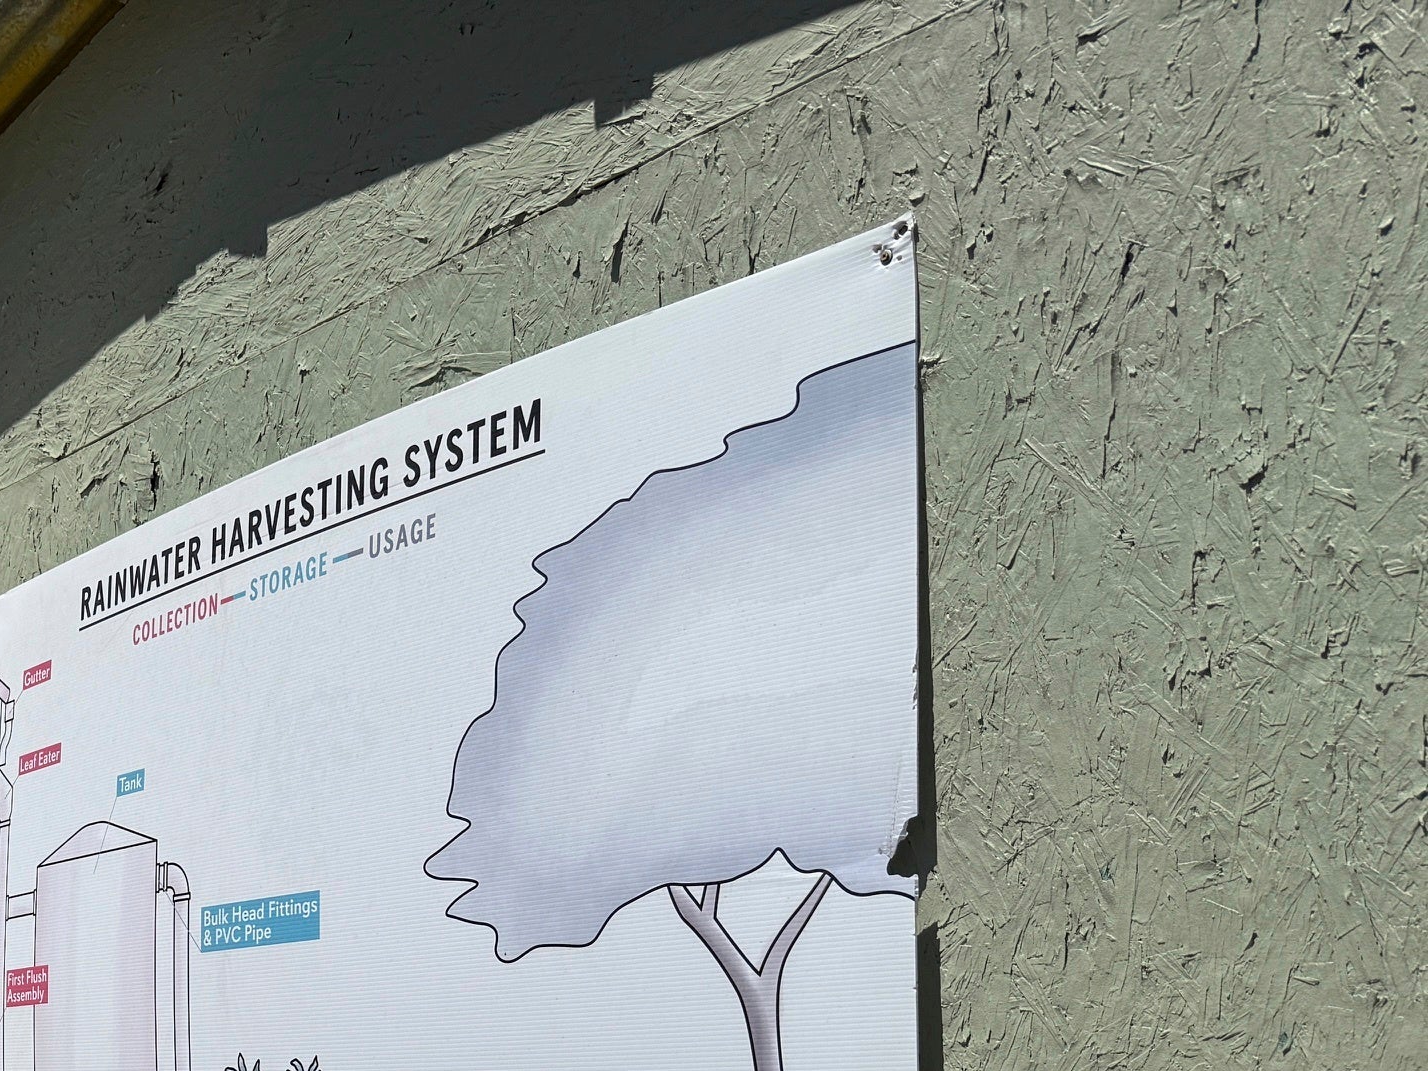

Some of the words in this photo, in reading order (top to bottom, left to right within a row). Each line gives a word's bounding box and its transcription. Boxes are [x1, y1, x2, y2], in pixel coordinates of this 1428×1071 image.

[80, 535, 201, 621] RAINWATER
[211, 458, 388, 564] HARVESTING
[402, 398, 542, 488] SYSTEM
[132, 592, 219, 646] COLLECTION
[249, 551, 328, 601] STORAGE
[368, 512, 437, 559] USAGE
[24, 666, 50, 685] Gutter
[20, 754, 37, 773] Leaf
[38, 748, 61, 767] Eater
[119, 774, 142, 793] Tank
[203, 908, 228, 927] Bulk
[231, 903, 265, 923] Head
[268, 898, 318, 920] Fittings
[203, 930, 213, 947] &
[215, 927, 242, 945] PVC
[244, 926, 272, 944] Pipe
[7, 971, 25, 986] First
[26, 969, 48, 984] Flush
[6, 986, 45, 1003] Assembly
